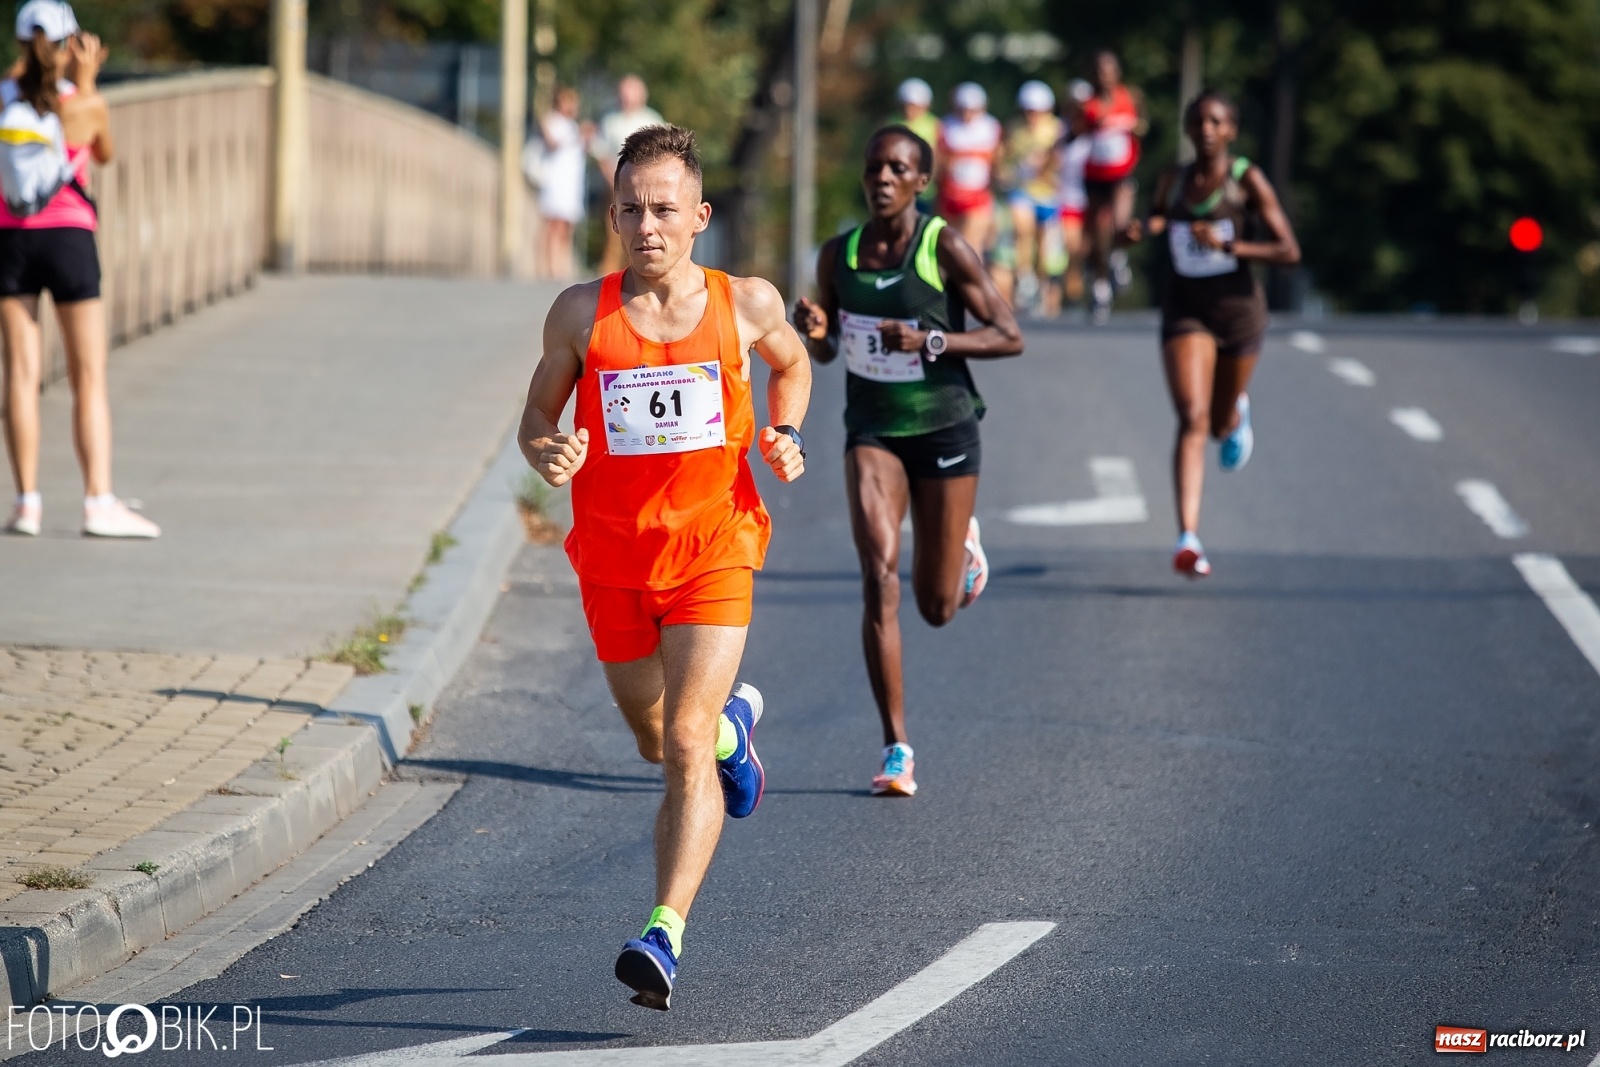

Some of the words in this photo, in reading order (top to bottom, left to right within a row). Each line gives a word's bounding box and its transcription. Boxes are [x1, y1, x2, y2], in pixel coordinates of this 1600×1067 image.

[640, 371, 674, 379] RAFAKO
[649, 389, 682, 418] 61
[655, 421, 679, 429] DAMIAN
